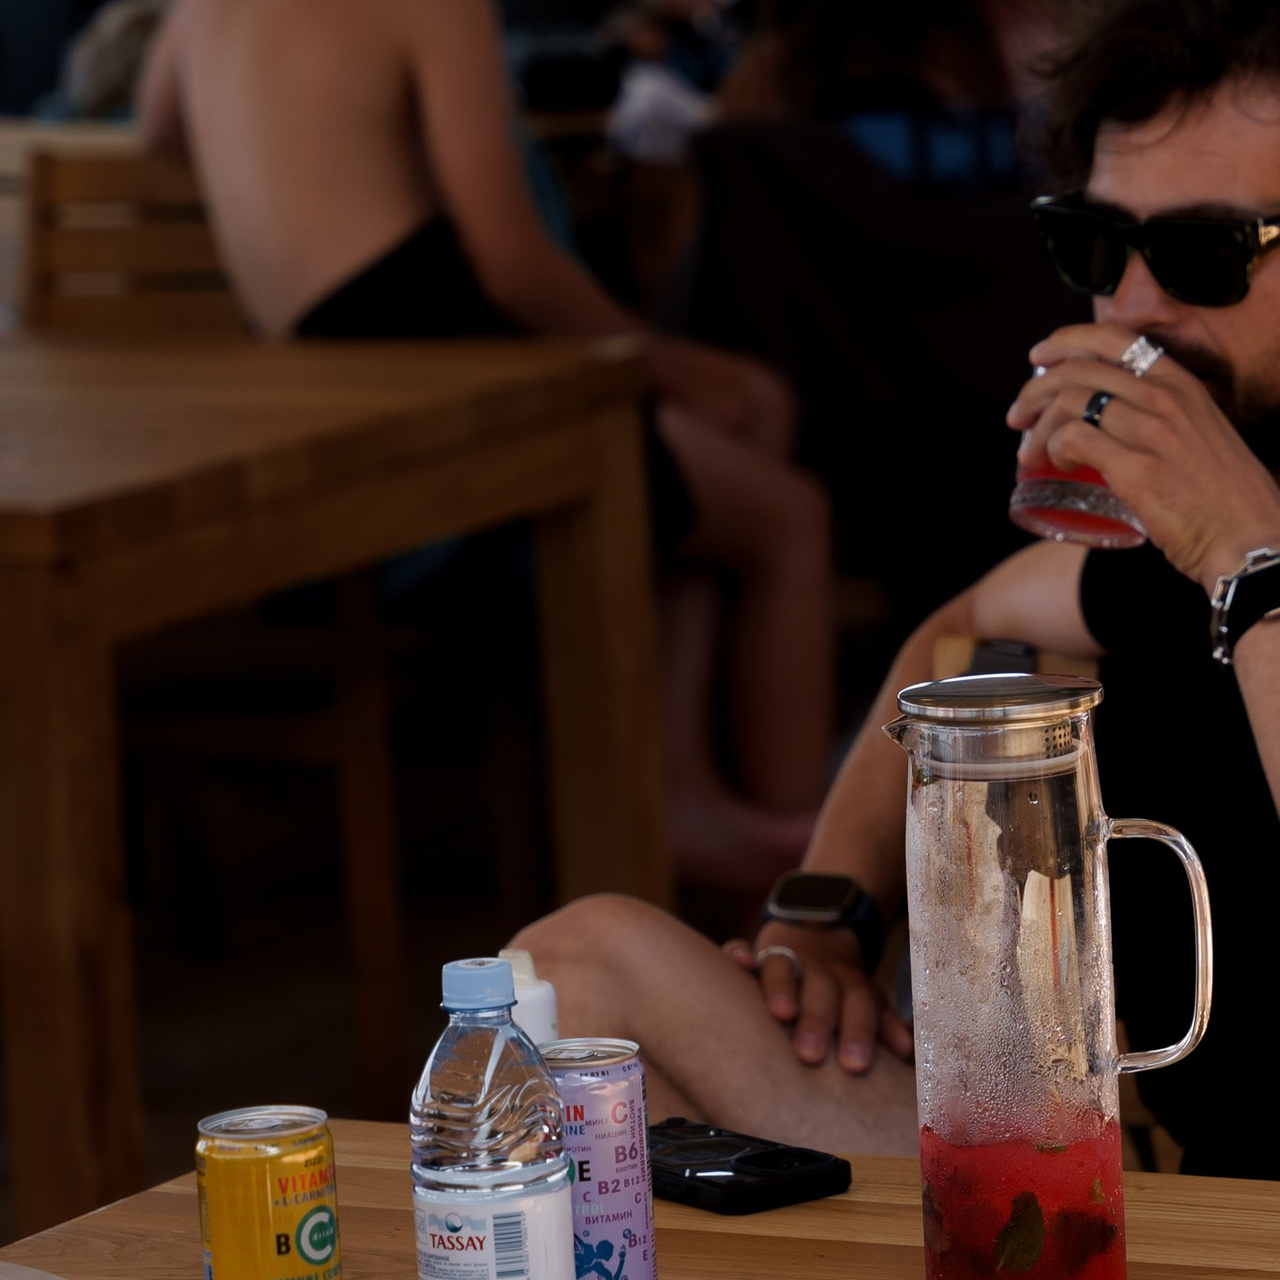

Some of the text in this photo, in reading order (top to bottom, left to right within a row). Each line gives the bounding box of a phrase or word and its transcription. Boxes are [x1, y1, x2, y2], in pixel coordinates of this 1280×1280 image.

[565, 1104, 585, 1122] IN
[565, 1125, 586, 1136] INE
[615, 1142, 639, 1164] B6
[578, 1160, 591, 1182] E
[598, 1179, 621, 1195] B2
[574, 1203, 607, 1216] TROL
[585, 1210, 633, 1225] ВИТАМИН
[429, 1233, 487, 1252] TASSAY
